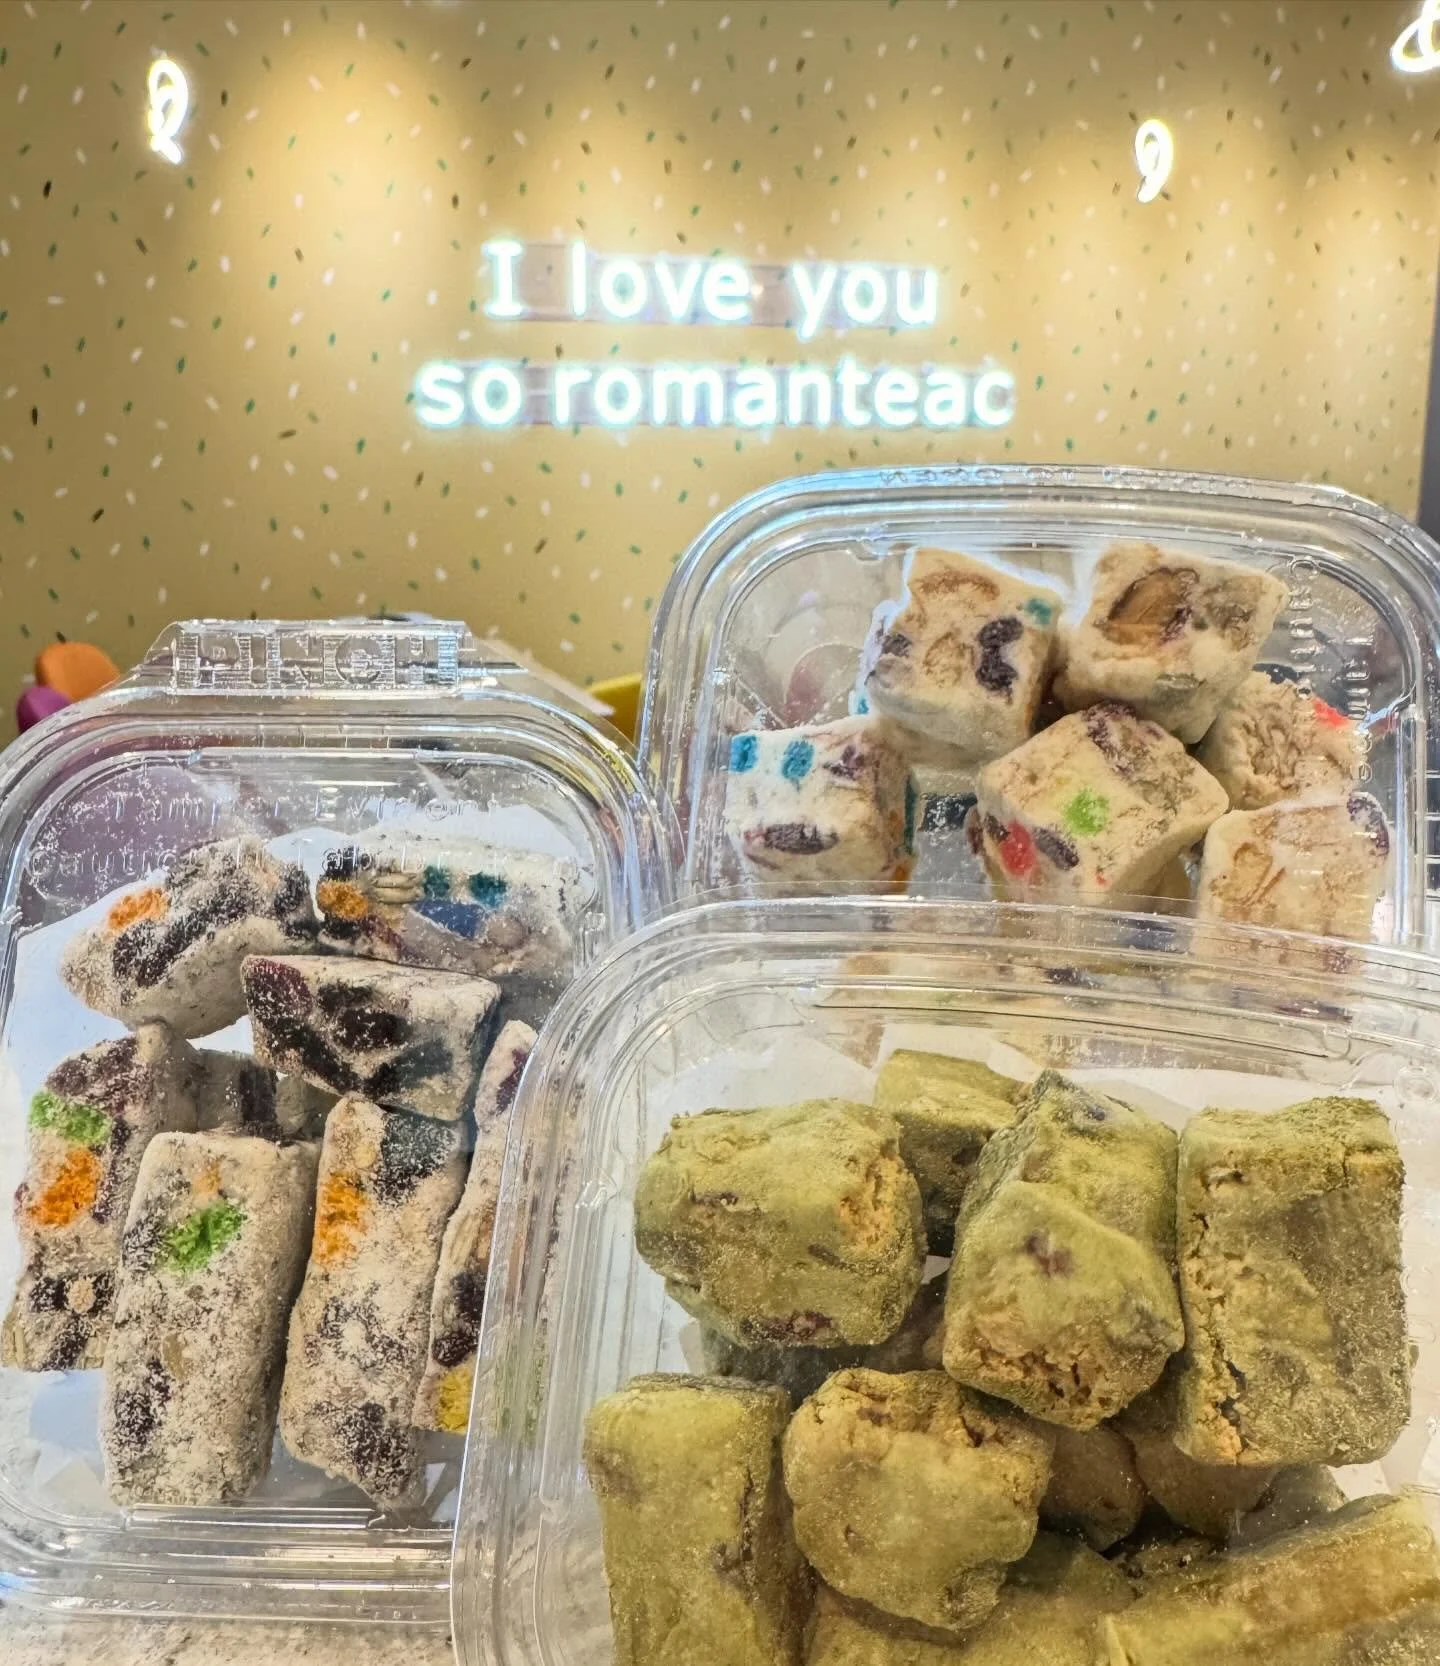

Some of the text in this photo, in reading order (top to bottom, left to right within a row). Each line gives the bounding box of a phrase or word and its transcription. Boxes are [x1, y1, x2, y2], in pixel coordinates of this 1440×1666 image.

[482, 239, 938, 341] I love you
[416, 353, 1015, 426] so romanteac
